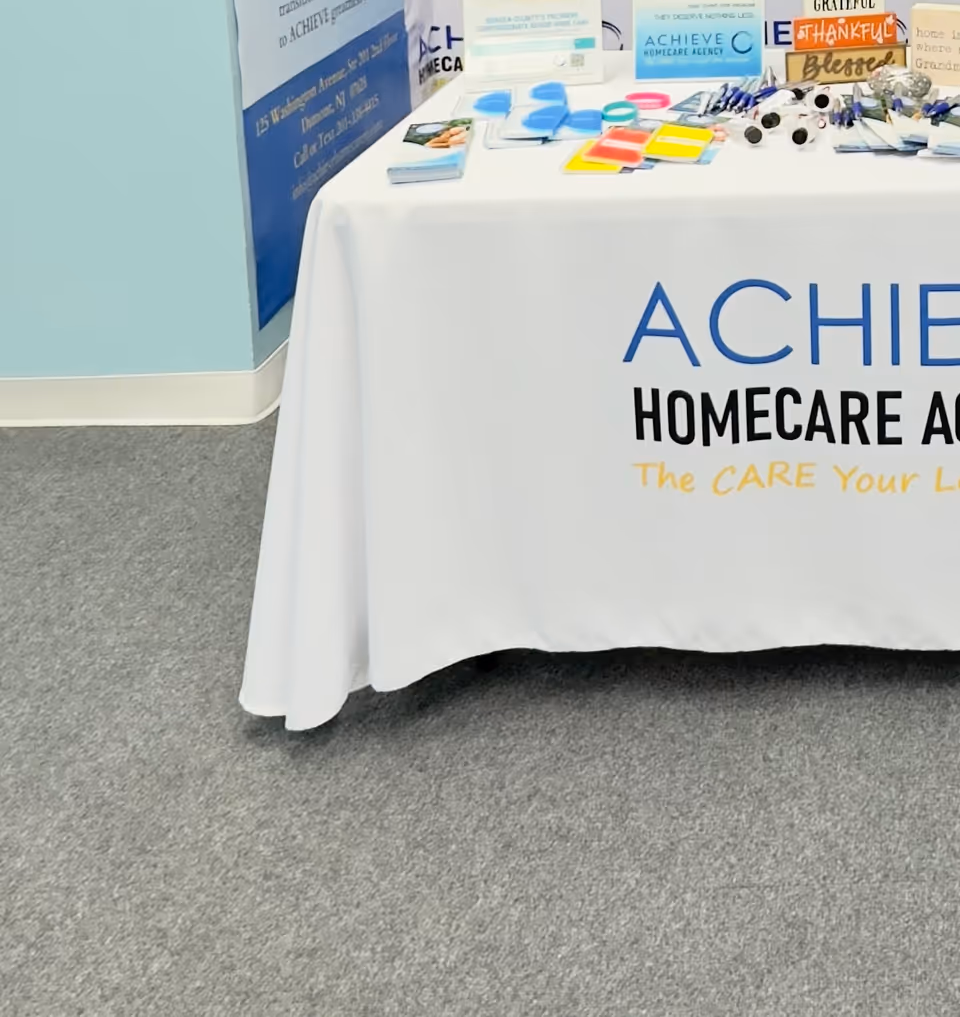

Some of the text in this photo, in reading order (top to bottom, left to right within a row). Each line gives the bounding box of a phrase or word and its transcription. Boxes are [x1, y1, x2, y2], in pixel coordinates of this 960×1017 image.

[280, 35, 288, 48] to
[290, 7, 330, 42] ACHIEVE
[801, 20, 893, 44] THANKFUL
[916, 27, 946, 40] home
[645, 33, 724, 47] ACHIEVE
[916, 41, 954, 54] where
[644, 47, 724, 57] HOMECARE AGENCY
[803, 50, 895, 81] Blessed
[336, 91, 346, 109] NJ
[256, 115, 270, 137] 125
[294, 129, 334, 168] Call Text
[634, 387, 902, 446] HOMECARE
[634, 462, 695, 494] The
[711, 461, 816, 497] CARE
[833, 465, 919, 494] Your
